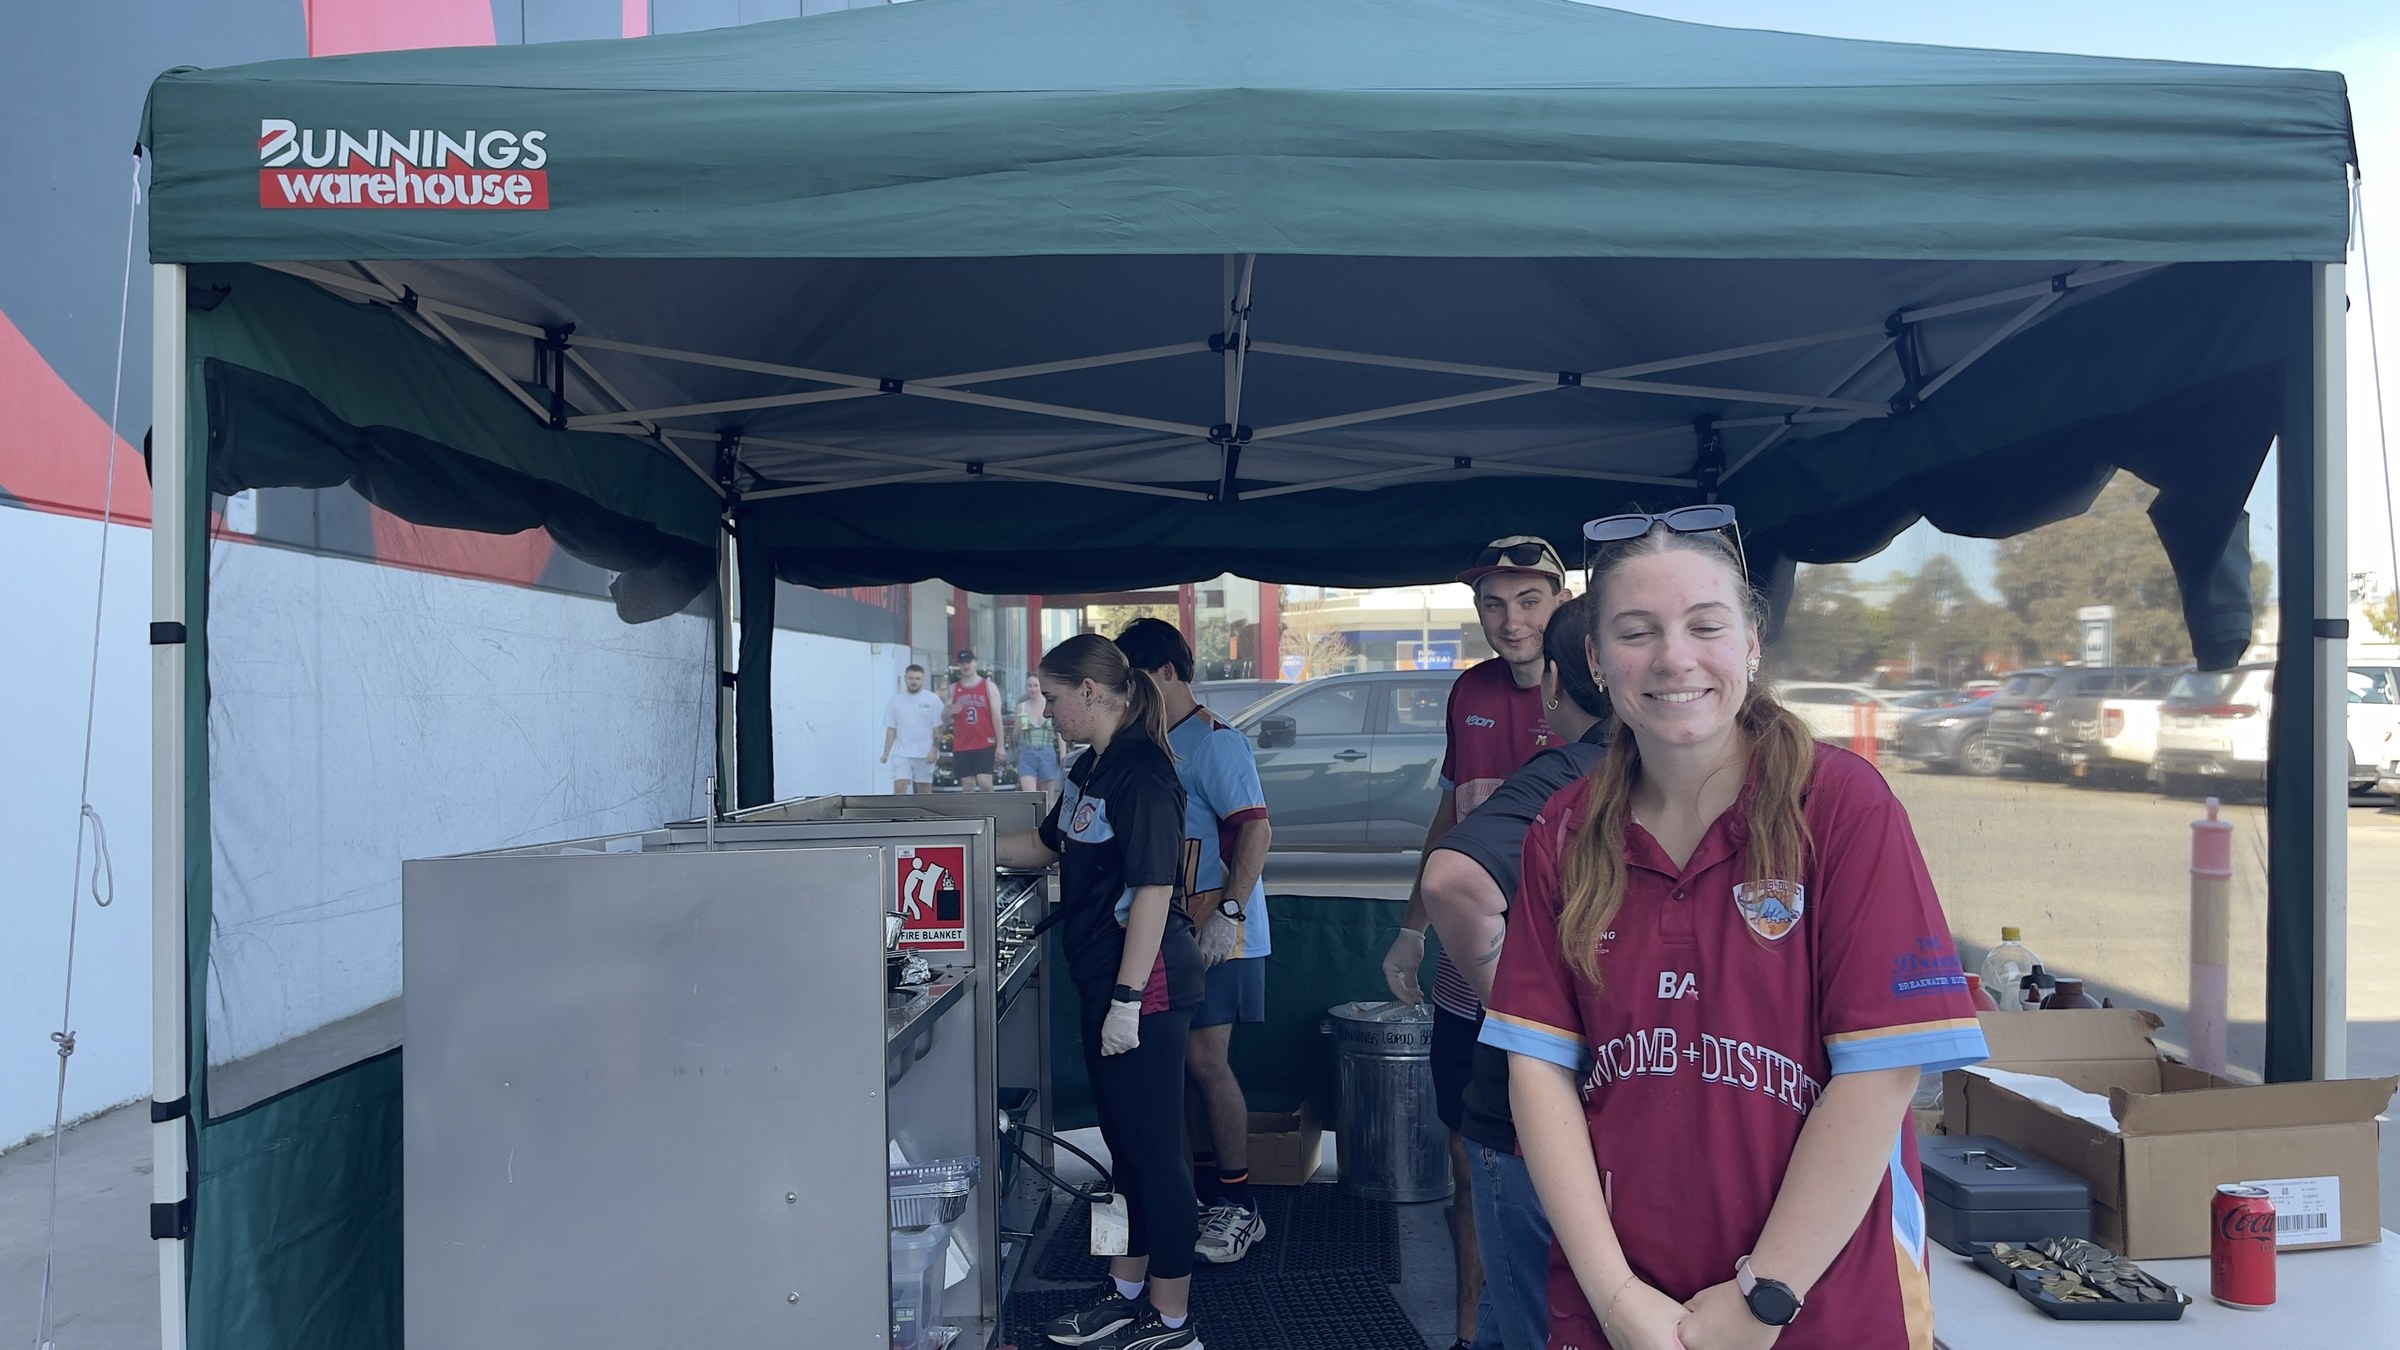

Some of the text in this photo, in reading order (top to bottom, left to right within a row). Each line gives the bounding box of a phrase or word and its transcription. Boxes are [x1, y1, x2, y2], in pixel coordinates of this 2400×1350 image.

[258, 118, 548, 169] BUNNINGS
[276, 158, 533, 206] warehouse
[966, 706, 977, 725] 3
[901, 930, 963, 940] FIRE BLANKET
[1657, 971, 1699, 1000] BA
[1898, 977, 1949, 991] BREAKWATER
[1382, 1031, 1414, 1046] LEOPOLD
